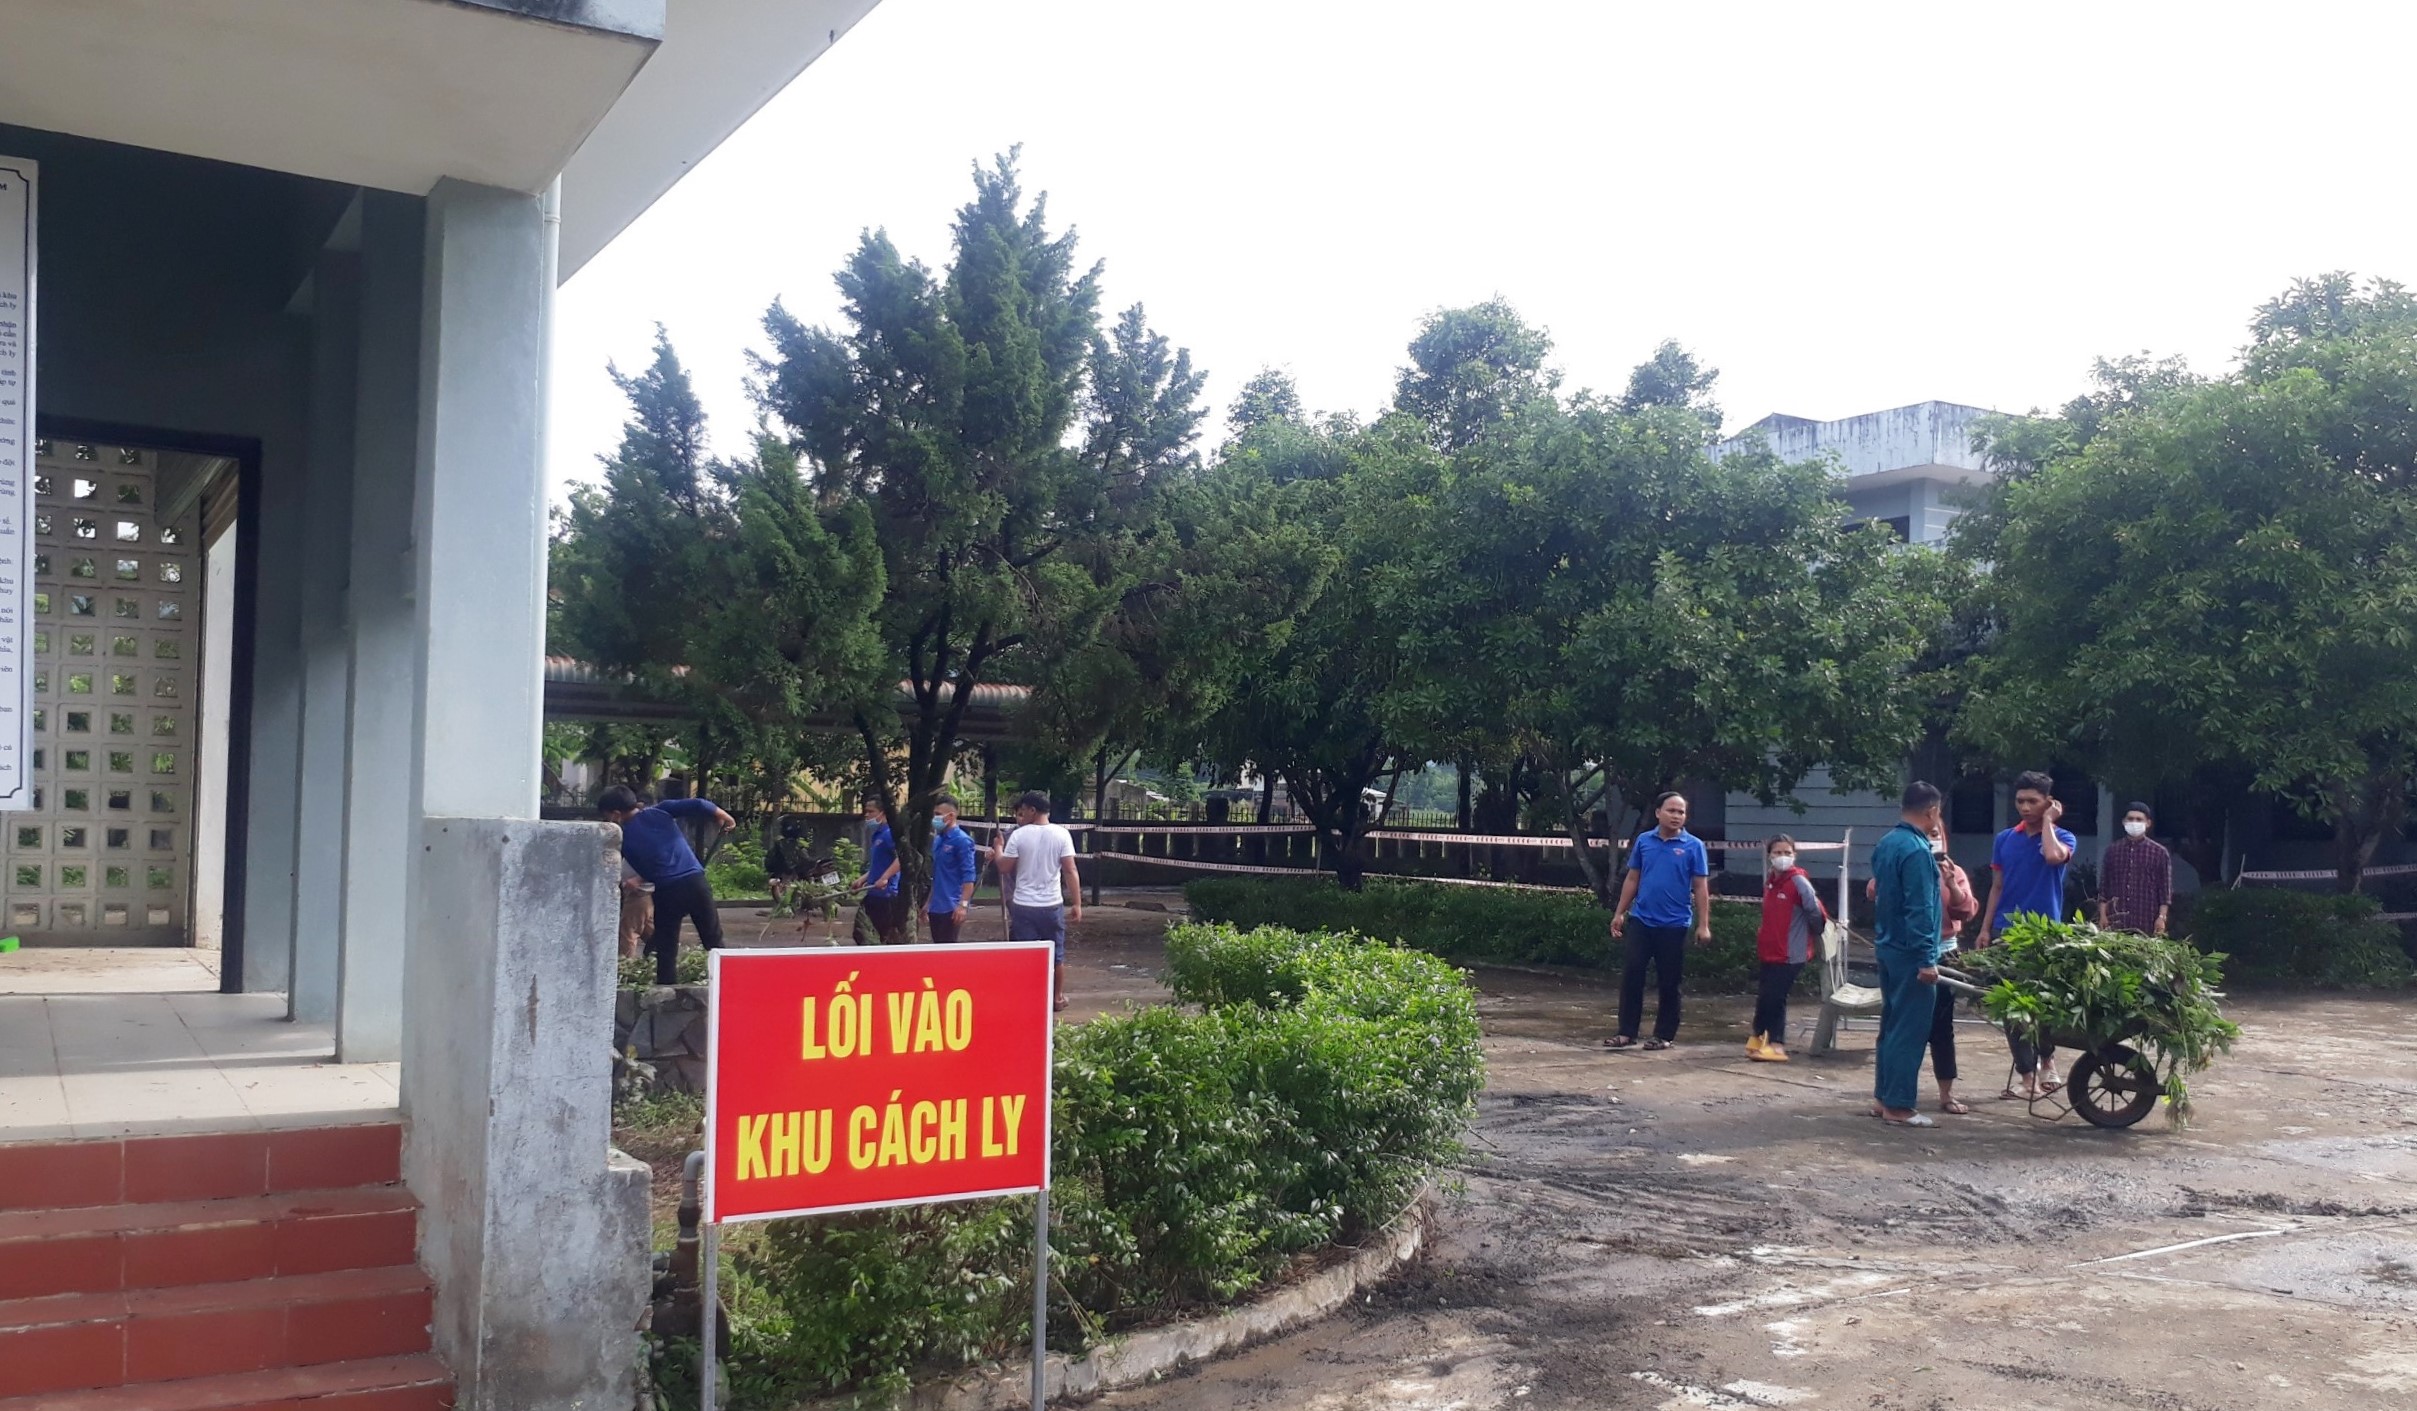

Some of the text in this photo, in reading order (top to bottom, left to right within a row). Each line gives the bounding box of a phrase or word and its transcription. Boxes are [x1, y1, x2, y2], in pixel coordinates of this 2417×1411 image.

[802, 970, 973, 1060] LỐI VÀO
[736, 1089, 1027, 1180] KHU CÁCH LY
